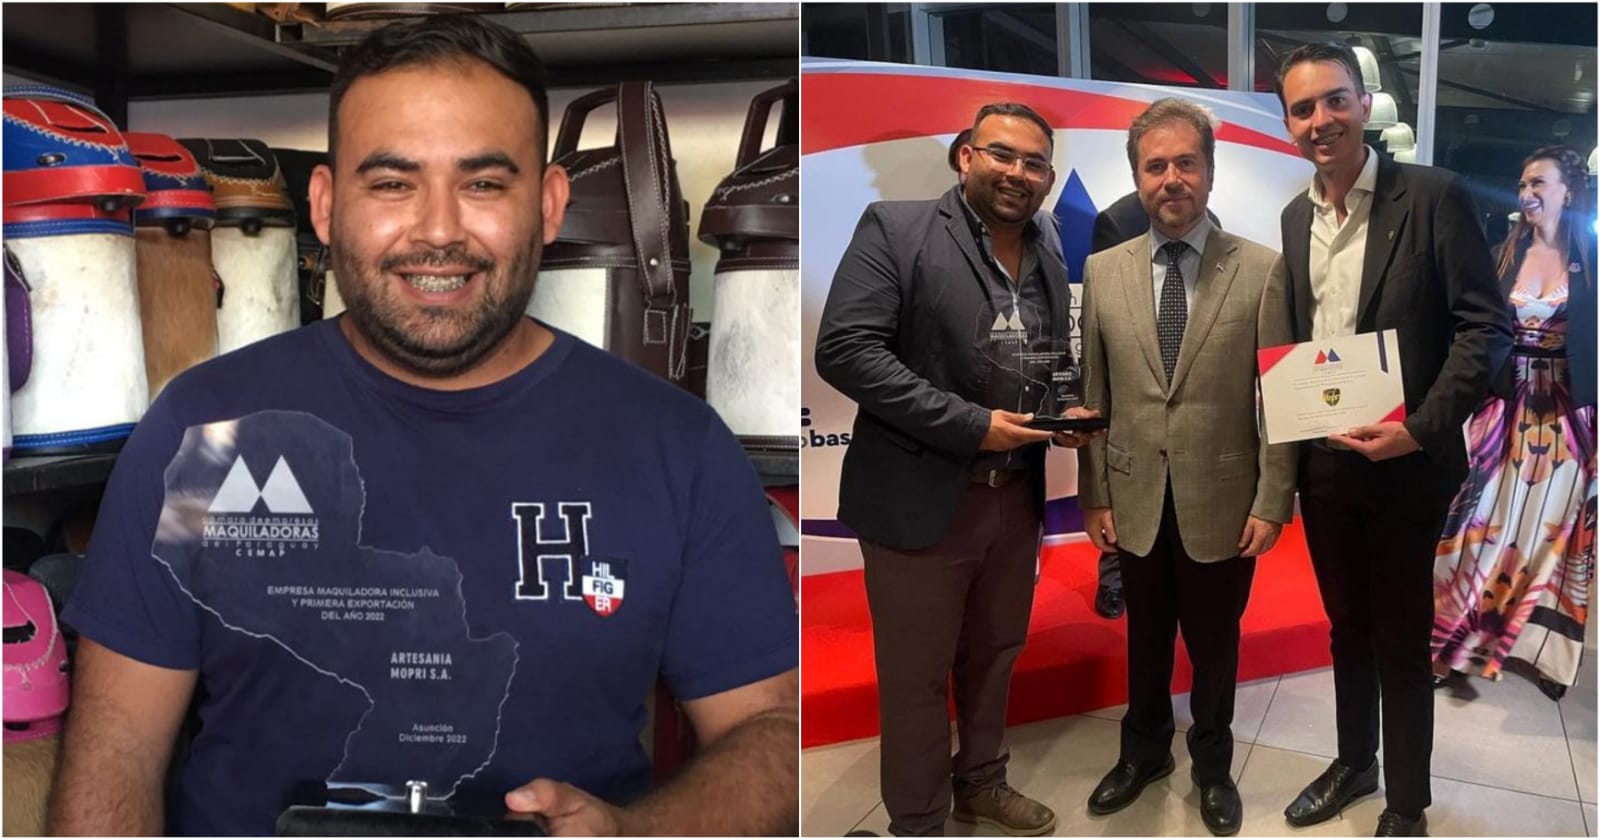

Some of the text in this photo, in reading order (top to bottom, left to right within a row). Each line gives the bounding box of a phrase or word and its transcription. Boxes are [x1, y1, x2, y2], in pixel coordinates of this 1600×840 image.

[203, 525, 319, 539] MAQUILADORAS
[235, 548, 285, 557] CEMAP
[512, 502, 591, 599] H
[592, 561, 616, 580] HIL
[267, 586, 440, 598] EMPRESA MAQUILADORA INCLUSIVA
[592, 579, 614, 595] FIG
[291, 598, 299, 607] Y
[300, 598, 346, 608] PRIMERA
[321, 610, 385, 622] DEL AÑO 2022
[390, 652, 452, 665] ARTESANIA
[390, 667, 453, 680] MOPRI S.A.
[399, 733, 468, 744] Diciembre 2022
